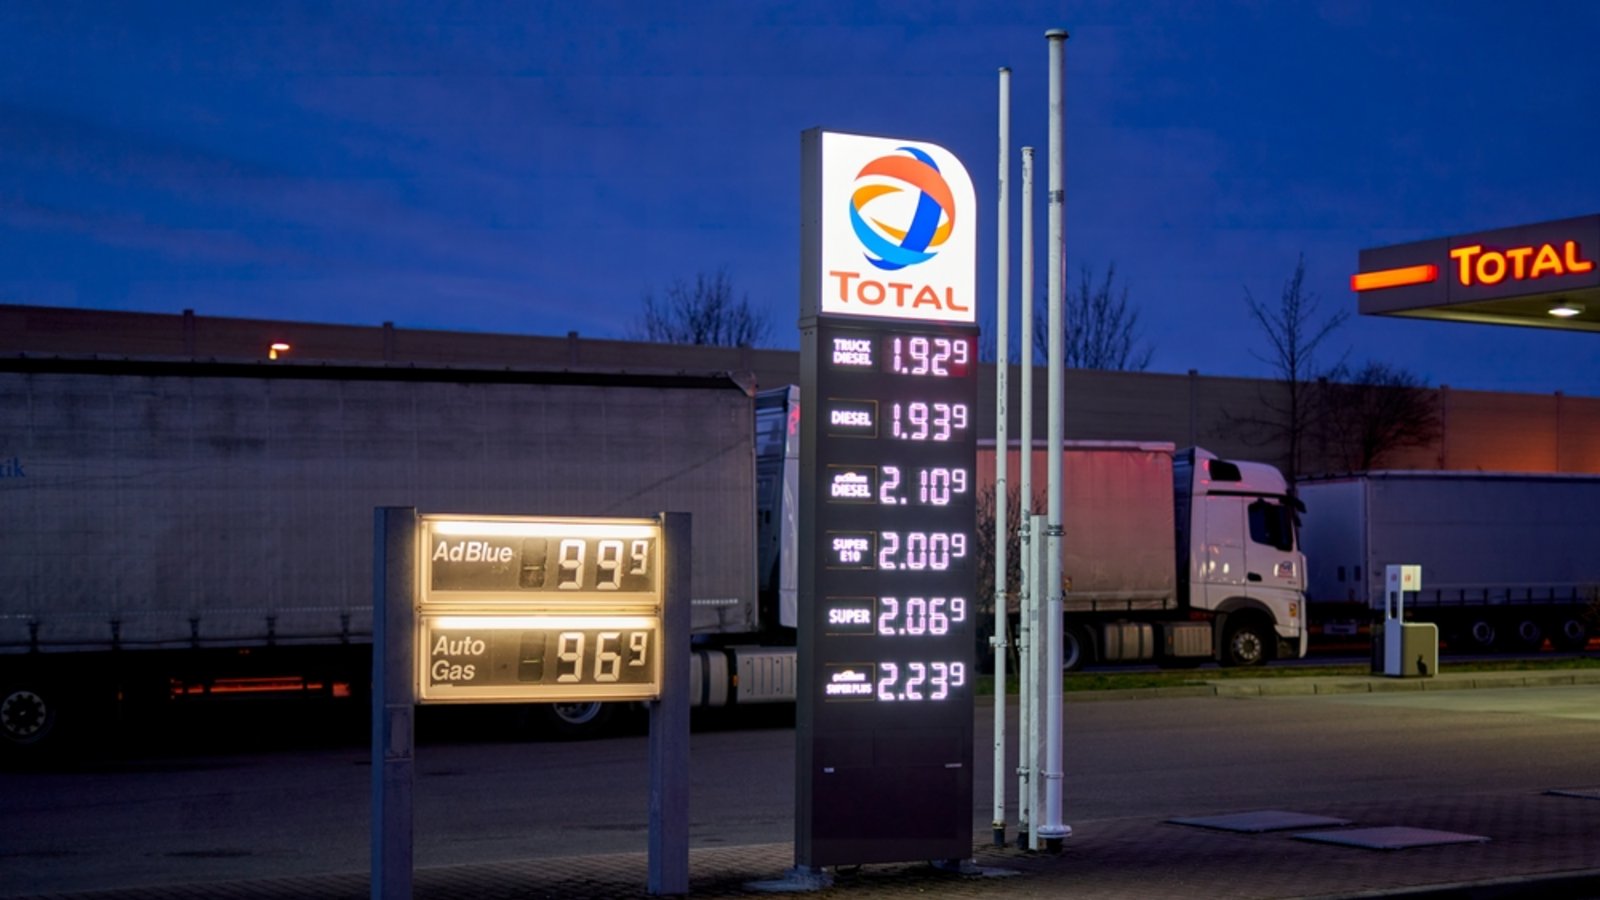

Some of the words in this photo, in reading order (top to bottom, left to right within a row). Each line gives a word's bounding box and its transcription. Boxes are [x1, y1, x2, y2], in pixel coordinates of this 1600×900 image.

[1450, 240, 1593, 287] TOTAL
[829, 270, 969, 313] TOTAL
[833, 338, 871, 352] TRUCK
[833, 351, 872, 365] DIESEL
[893, 337, 968, 376] 1.929
[831, 411, 872, 426] DIESEL
[892, 402, 968, 441] 1.939
[831, 482, 872, 498] DIESEL
[432, 540, 513, 563] AdBlue
[833, 538, 868, 551] SUPER
[879, 531, 966, 570] 2.009
[840, 550, 862, 562] E10
[828, 608, 871, 624] SUPER
[878, 597, 965, 635] 2.069
[431, 635, 485, 656] Auto
[431, 660, 476, 681] Gas
[877, 662, 965, 701] 2.239
